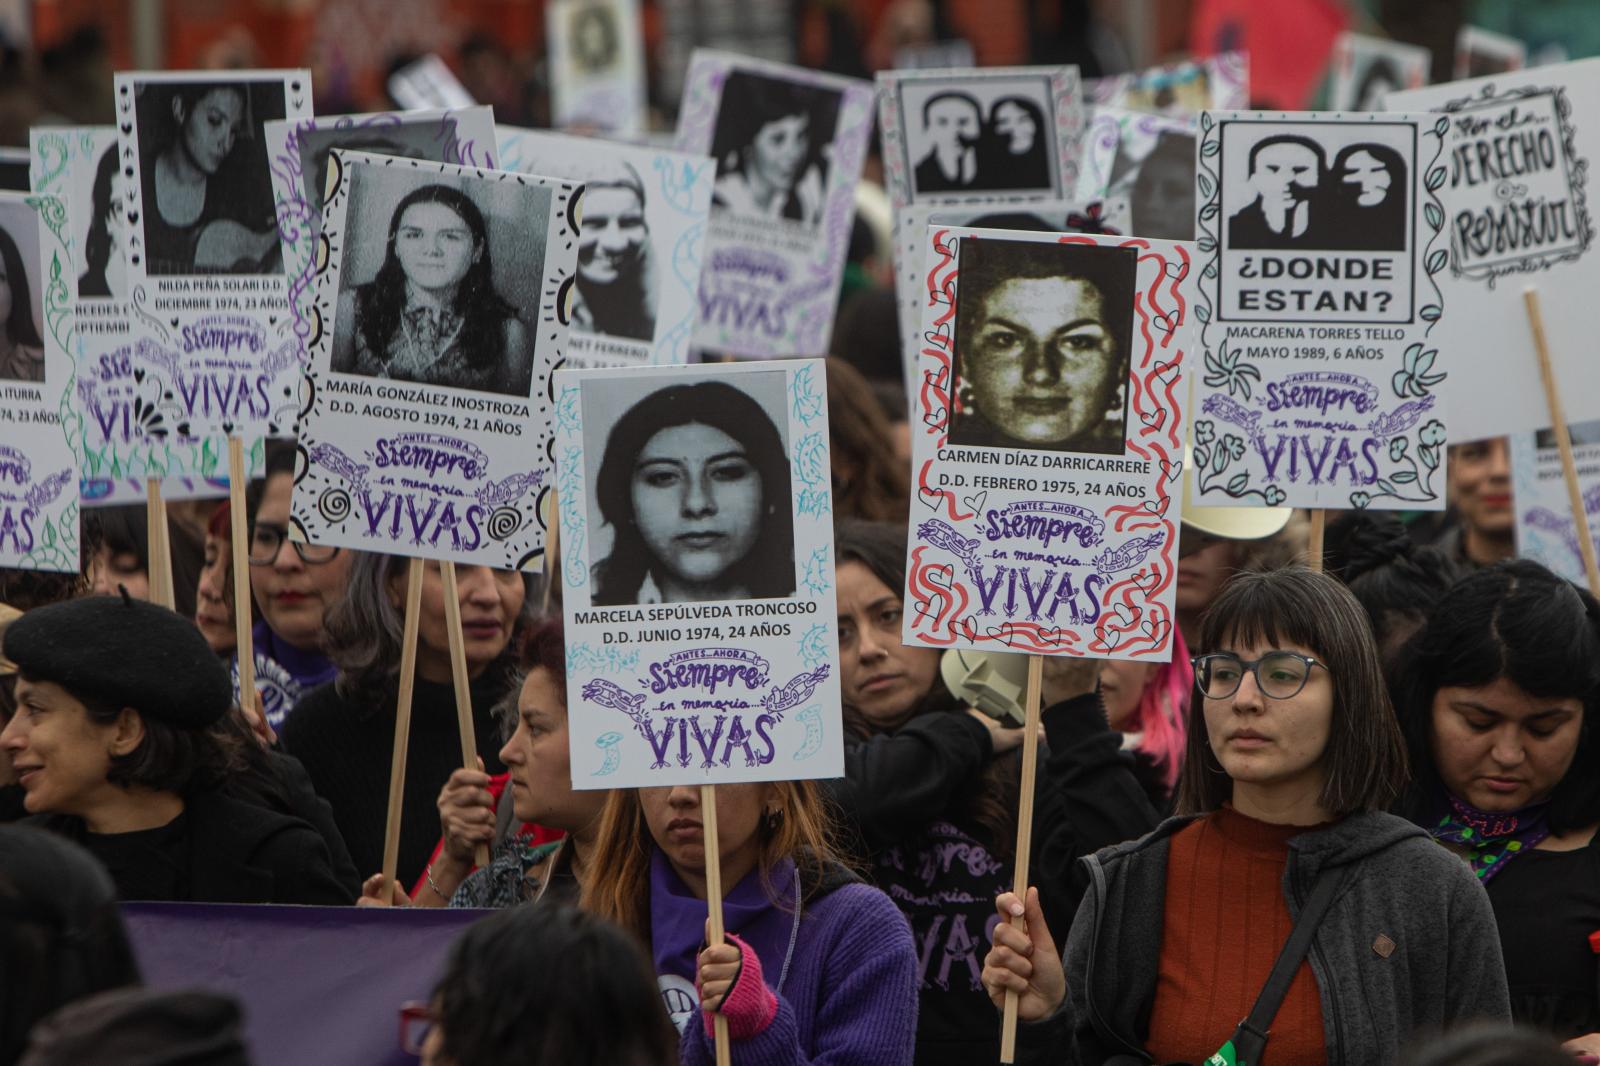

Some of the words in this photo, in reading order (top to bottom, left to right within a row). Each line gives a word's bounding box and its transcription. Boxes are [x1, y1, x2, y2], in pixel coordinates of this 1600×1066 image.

[1238, 257, 1393, 280] ¿DONDE
[158, 280, 190, 291] NILDA
[155, 298, 211, 310] DICIEMBRE
[245, 299, 257, 309] 23
[260, 296, 289, 309] AÑOS
[1238, 289, 1393, 312] ESTAN?
[1226, 326, 1305, 339] MACARENA
[1309, 327, 1361, 340] TORRES
[1364, 328, 1405, 341] TELLO
[1247, 346, 1289, 359] MAYO
[1294, 347, 1329, 361] 1989,
[1333, 348, 1342, 359] 6
[1345, 345, 1384, 360] AÑOS
[5, 386, 41, 401] ITURRA
[176, 374, 270, 419] VIVAS
[326, 380, 373, 397] MARÍA
[376, 385, 448, 406] GONZÁLEZ
[452, 397, 530, 417] INOSTROZA
[1266, 382, 1368, 416] Siempre
[18, 411, 30, 422] 23
[32, 410, 60, 425] AÑOS
[330, 400, 358, 414] D.D.
[362, 404, 420, 422] AGOSTO
[423, 412, 459, 429] 1974,
[464, 418, 478, 430] 21
[483, 419, 522, 436] AÑOS
[375, 438, 478, 480] Siempre
[937, 449, 1000, 465] CARMEN
[1005, 451, 1038, 467] DÍAZ
[1042, 455, 1150, 474] DARRICARRERE
[1257, 433, 1381, 487] VIVAS
[939, 474, 968, 487] D.D.
[974, 476, 1038, 491] FEBRERO
[1042, 480, 1080, 496] 1975,
[1085, 483, 1101, 495] 24
[1105, 482, 1146, 498] AÑOS
[359, 489, 483, 552] VIVAS
[986, 509, 1094, 548] Siempre
[972, 565, 1103, 625] VIVAS
[574, 610, 645, 625] MARCELA
[648, 604, 732, 621] SEPÚLVEDA
[736, 601, 817, 617] TRONCOSO
[603, 631, 633, 644] D.D.
[637, 628, 682, 642] JUNIO
[686, 627, 724, 640] 1974,
[728, 626, 746, 638] 24
[750, 622, 791, 637] AÑOS
[649, 661, 759, 695] Siempre
[641, 715, 776, 769] VIVAS
